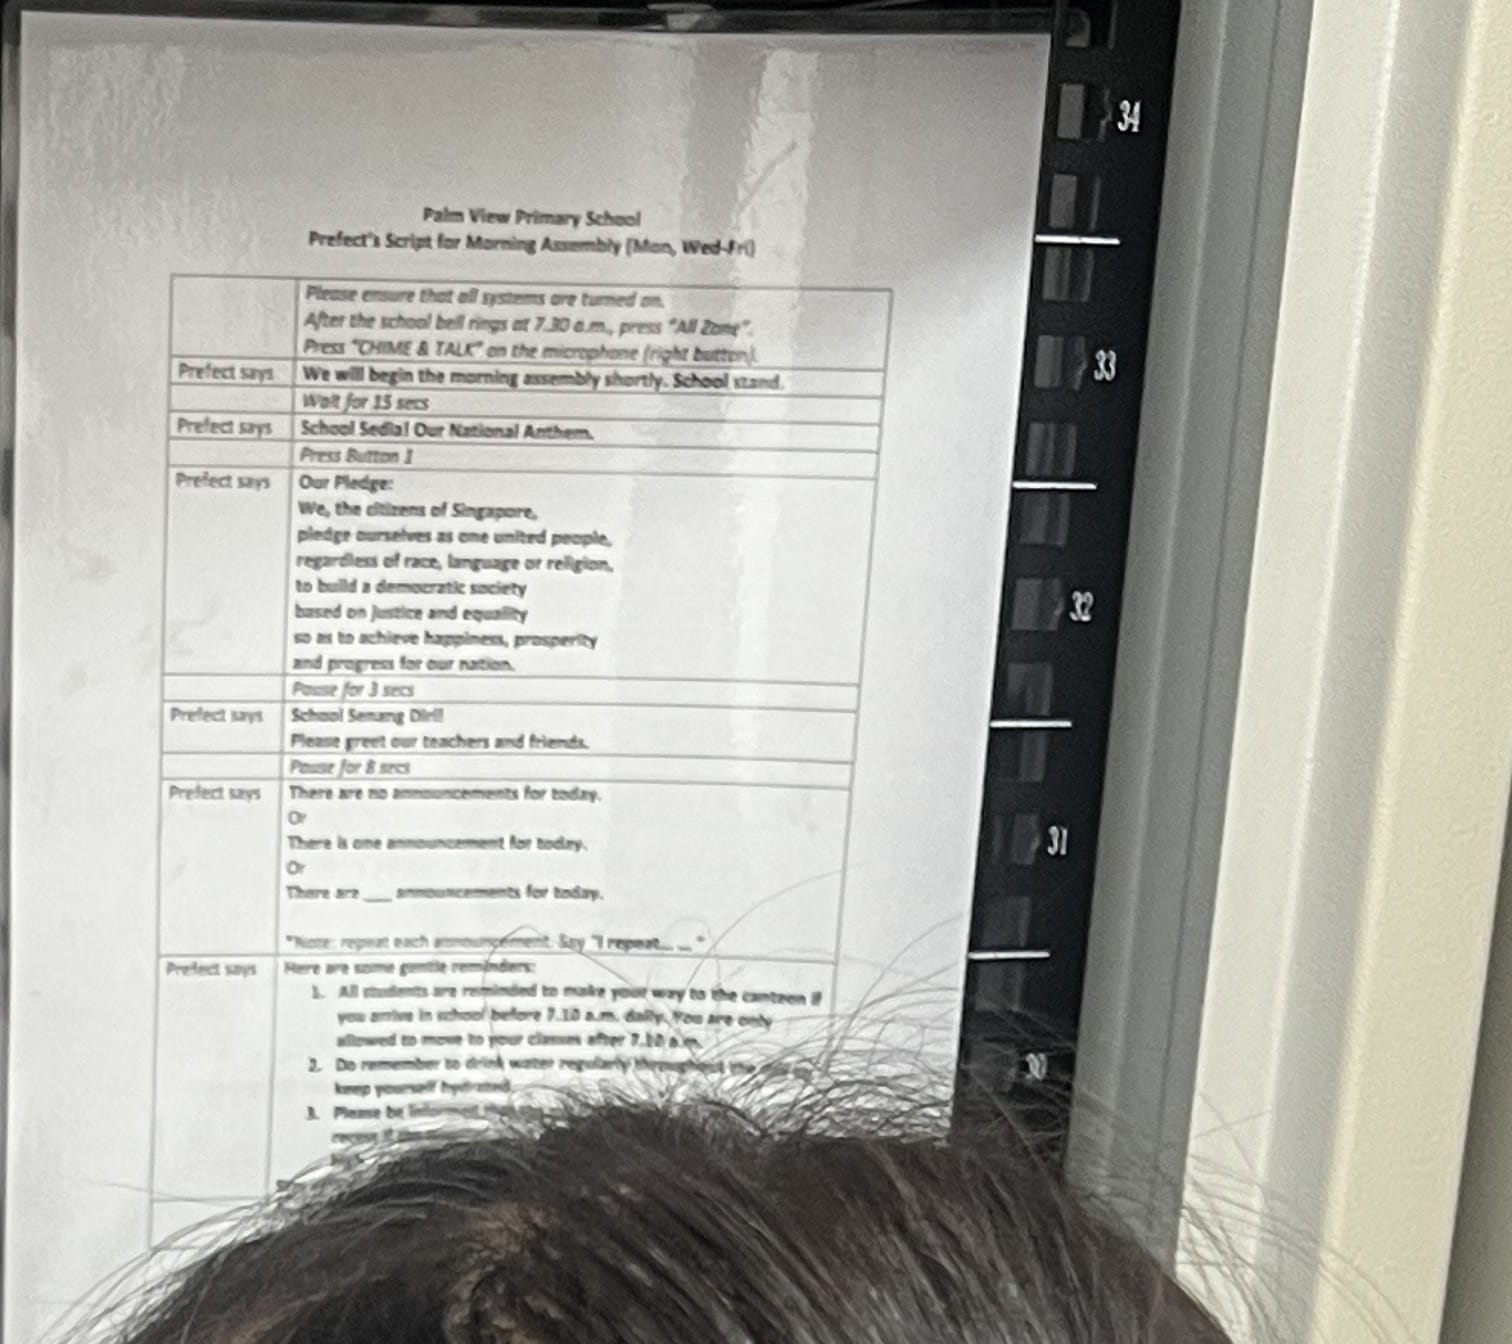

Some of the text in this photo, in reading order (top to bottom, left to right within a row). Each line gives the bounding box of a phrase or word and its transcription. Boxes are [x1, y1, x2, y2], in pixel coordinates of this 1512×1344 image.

[1117, 100, 1140, 132] 34
[421, 205, 642, 229] Palm View Primary School
[307, 229, 381, 248] Prefect's
[384, 230, 433, 252] Script
[435, 231, 462, 250] for
[464, 233, 537, 255] Morning
[539, 235, 622, 256] Assembly
[301, 364, 784, 392] We will begin the morning assembly shortly. School stand.
[1094, 349, 1116, 381] 33
[175, 415, 273, 438] Prefect says
[299, 418, 356, 437] School
[411, 420, 446, 438] Our
[447, 422, 520, 437] National
[521, 423, 595, 440] Anthem.
[297, 472, 394, 494] Our Pledge:
[296, 499, 539, 522] We, the citizens of Singapore,
[1070, 591, 1093, 622] 32
[289, 706, 344, 723] School
[346, 706, 405, 727] Senang
[289, 731, 590, 757] Please greet our teachers and friends.
[1047, 825, 1068, 855] 31
